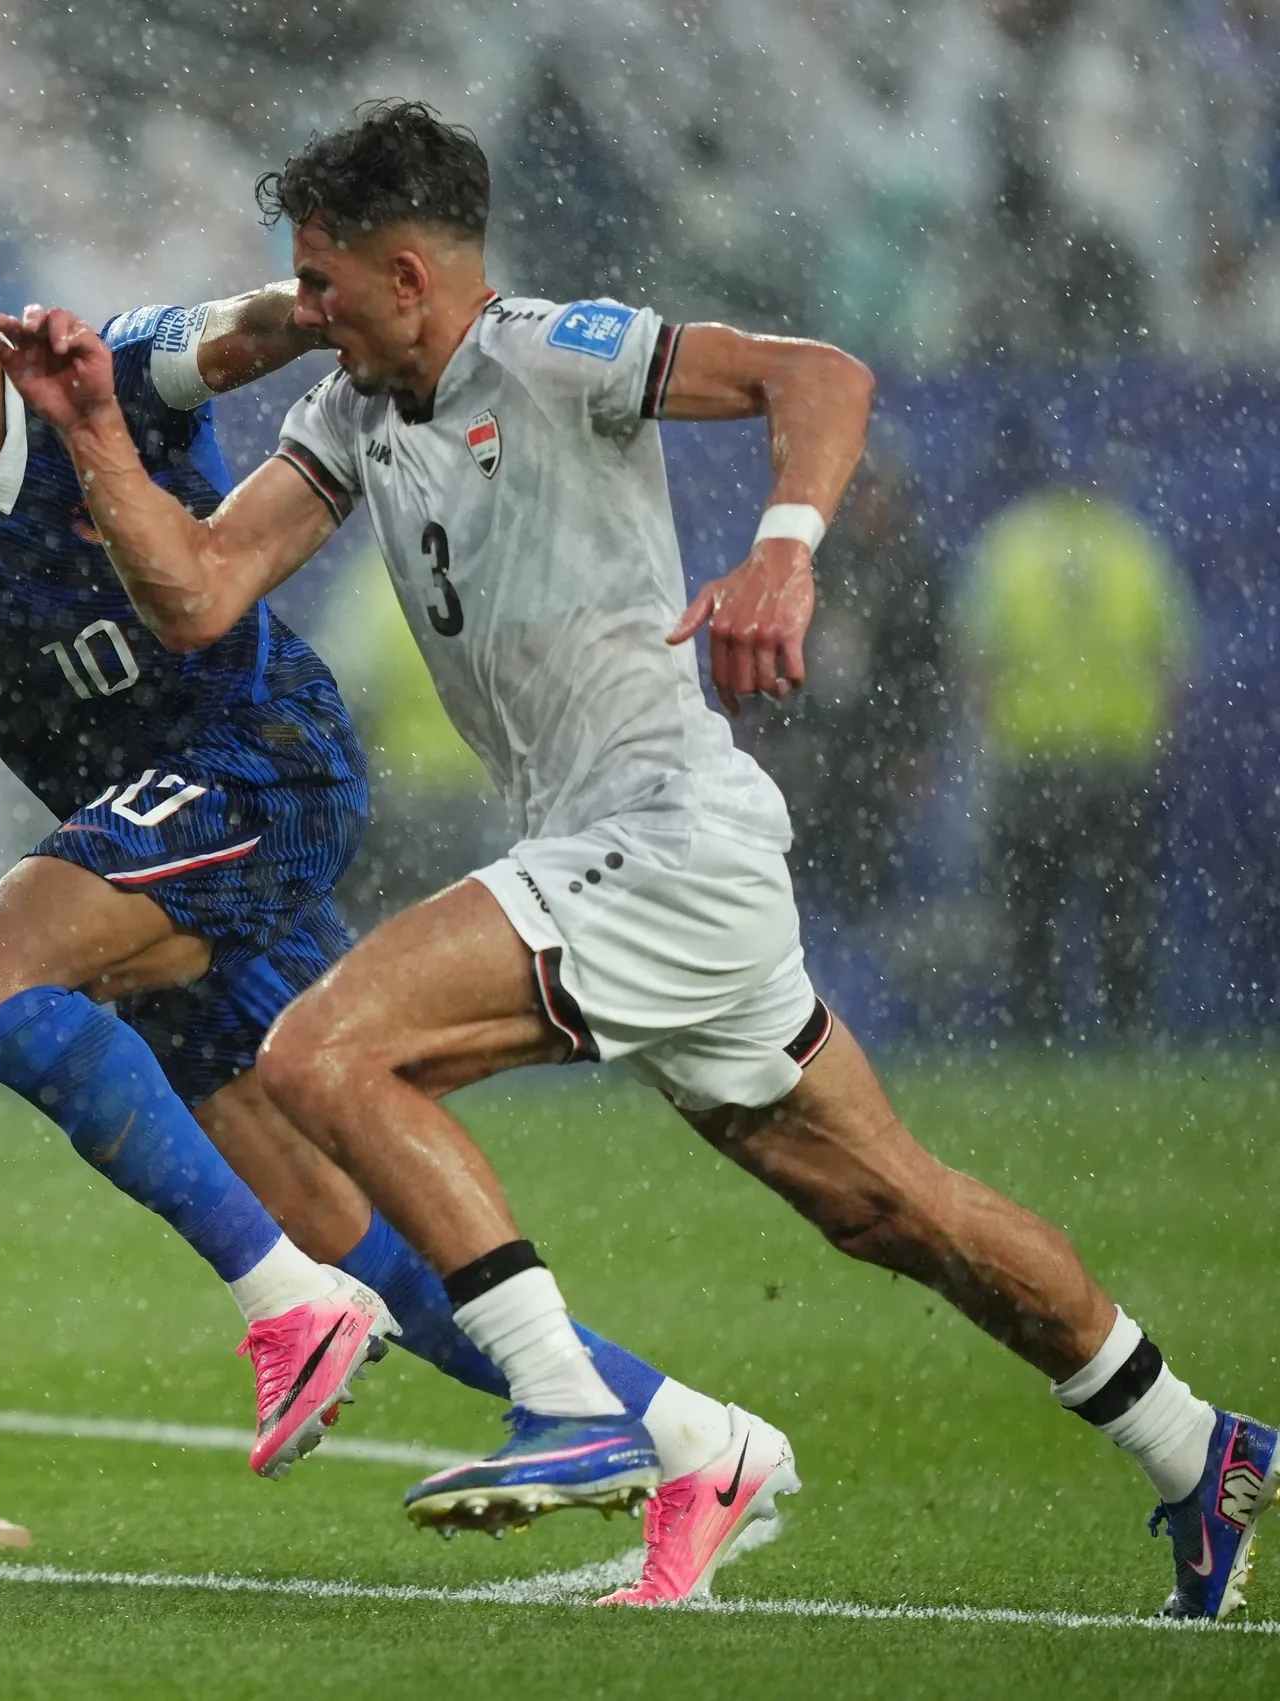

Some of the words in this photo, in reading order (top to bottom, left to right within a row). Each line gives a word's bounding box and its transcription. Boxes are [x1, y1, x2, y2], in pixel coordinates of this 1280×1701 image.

[153, 308, 183, 351] FOOTBA
[166, 312, 187, 353] UNIT
[365, 439, 392, 466] JAK
[421, 521, 464, 638] 3
[40, 619, 140, 700] 10
